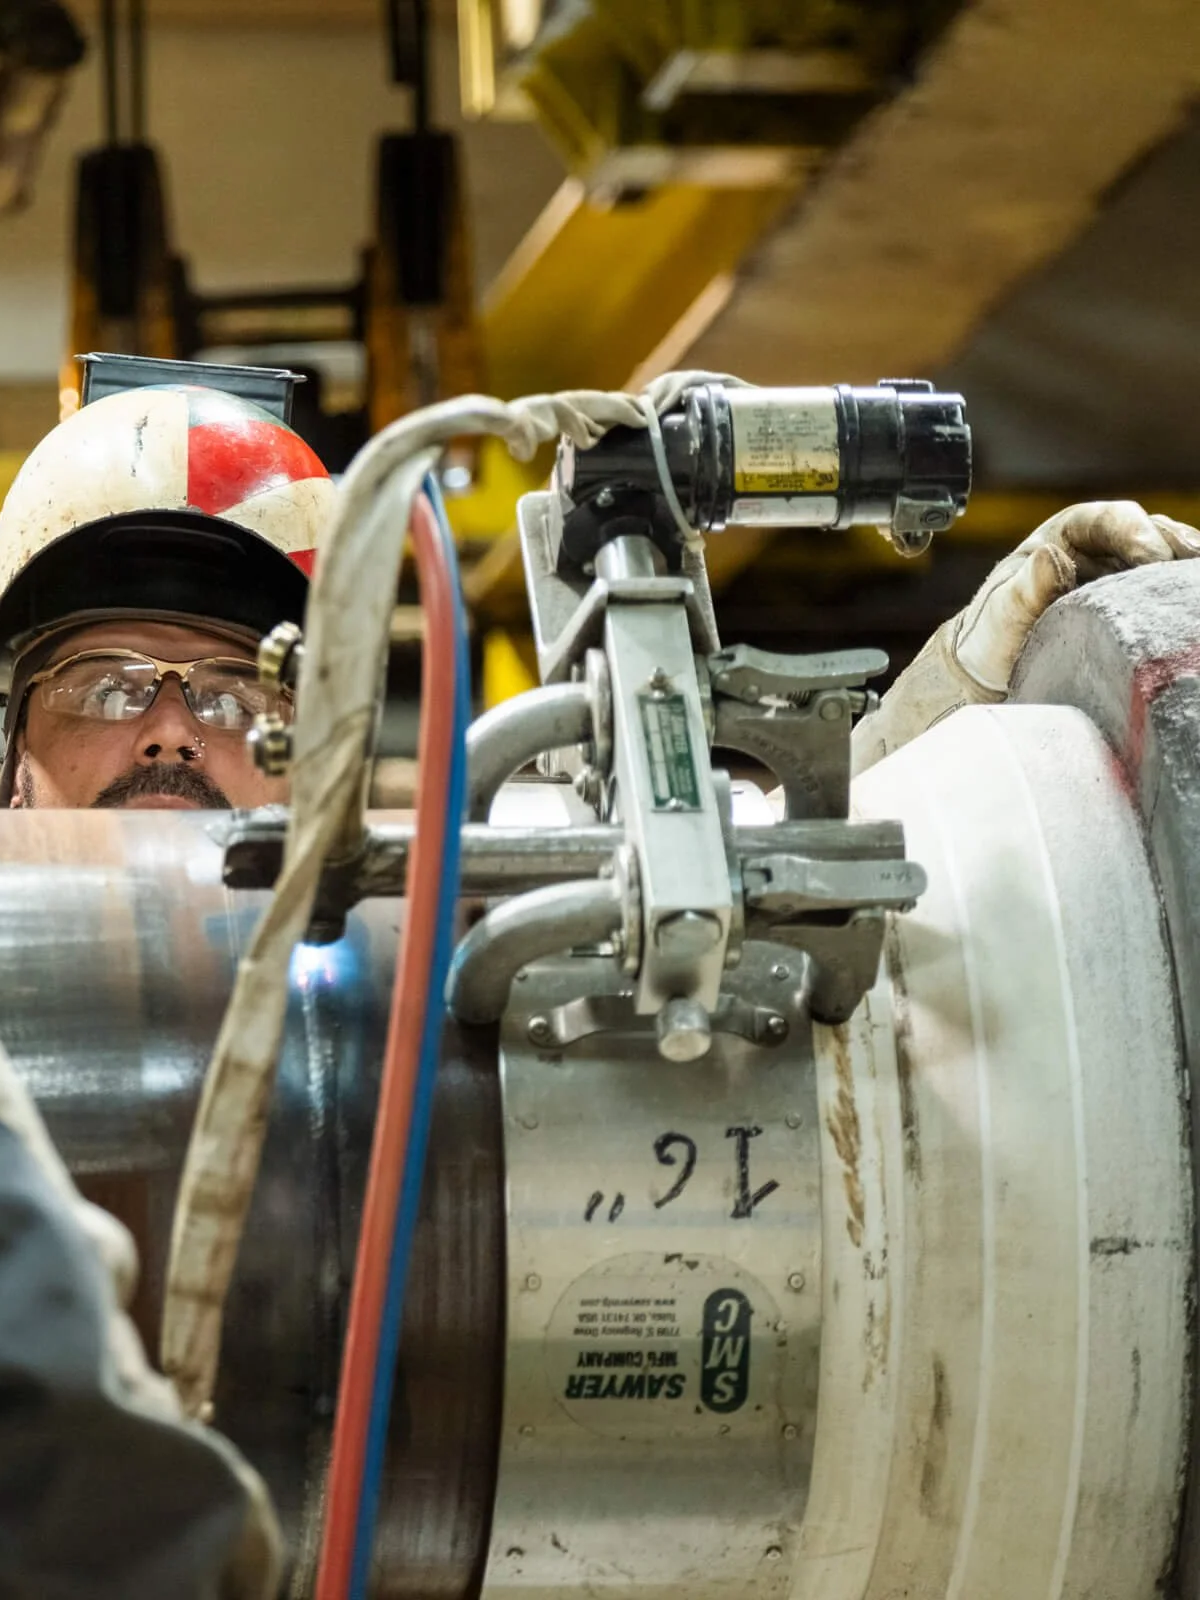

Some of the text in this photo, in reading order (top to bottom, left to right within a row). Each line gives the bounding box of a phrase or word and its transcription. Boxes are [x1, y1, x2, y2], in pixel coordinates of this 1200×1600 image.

[577, 1312, 599, 1322] USA
[632, 1312, 647, 1322] OK
[573, 1327, 599, 1337] Drive
[601, 1326, 643, 1337] Regency
[577, 1351, 643, 1367] COMPANY
[565, 1374, 686, 1400] SAWYER
